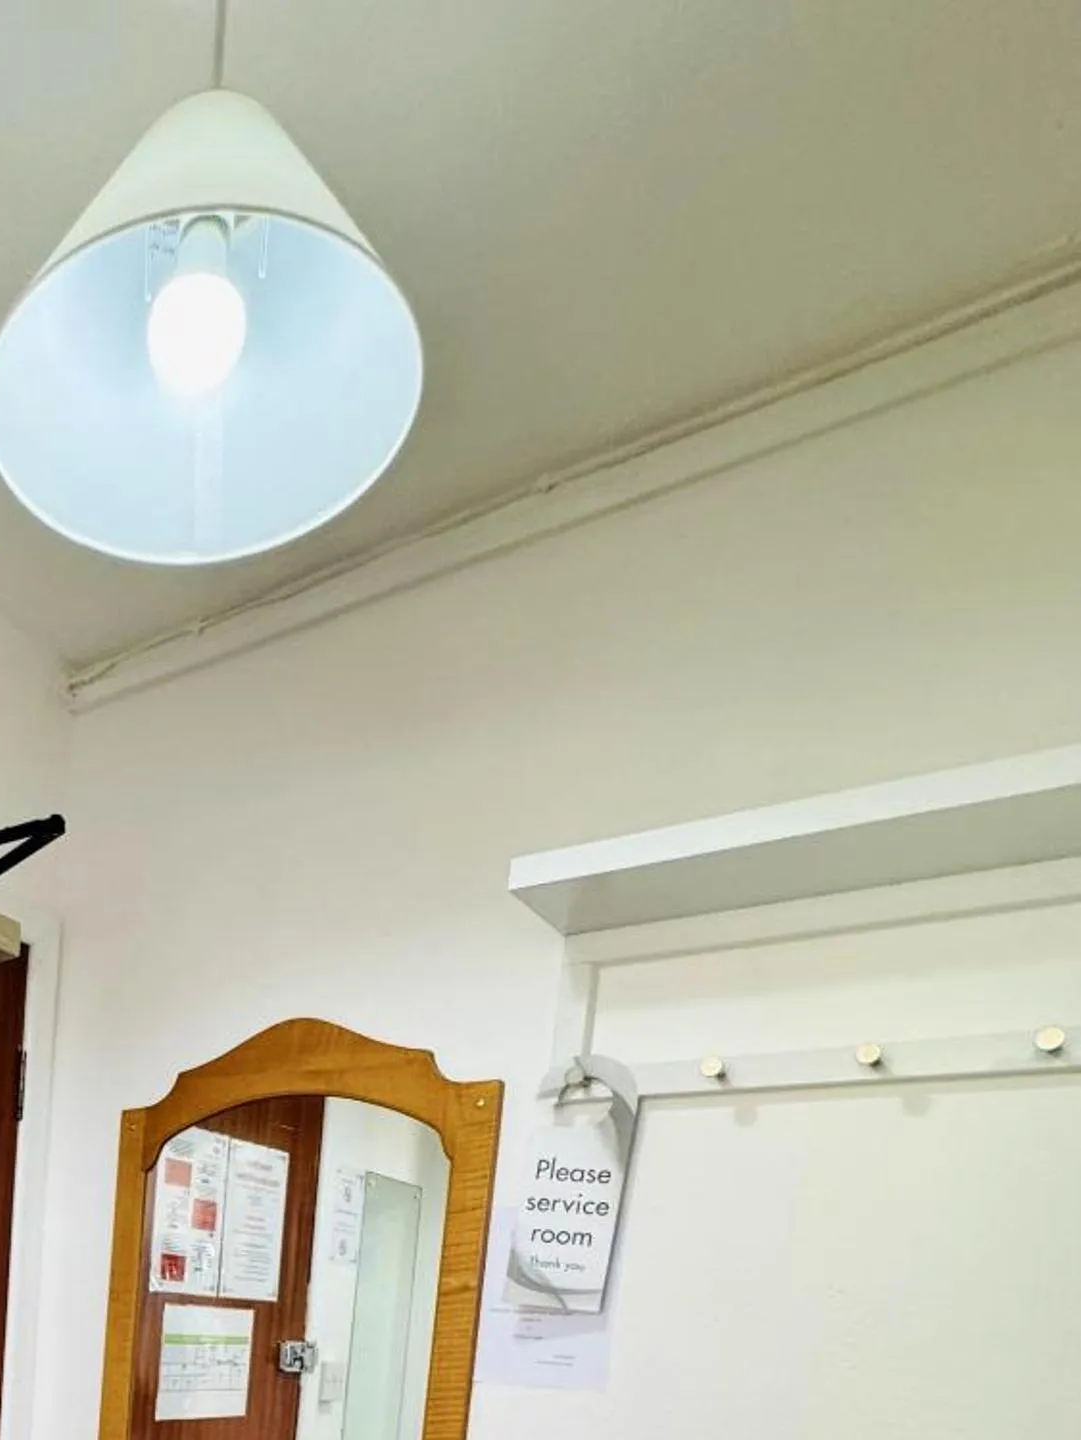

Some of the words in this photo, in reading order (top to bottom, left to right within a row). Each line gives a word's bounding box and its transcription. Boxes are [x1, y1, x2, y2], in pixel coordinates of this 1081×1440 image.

[535, 1156, 612, 1184] Please
[525, 1193, 610, 1217] service
[530, 1228, 593, 1248] room
[563, 1262, 587, 1272] you
